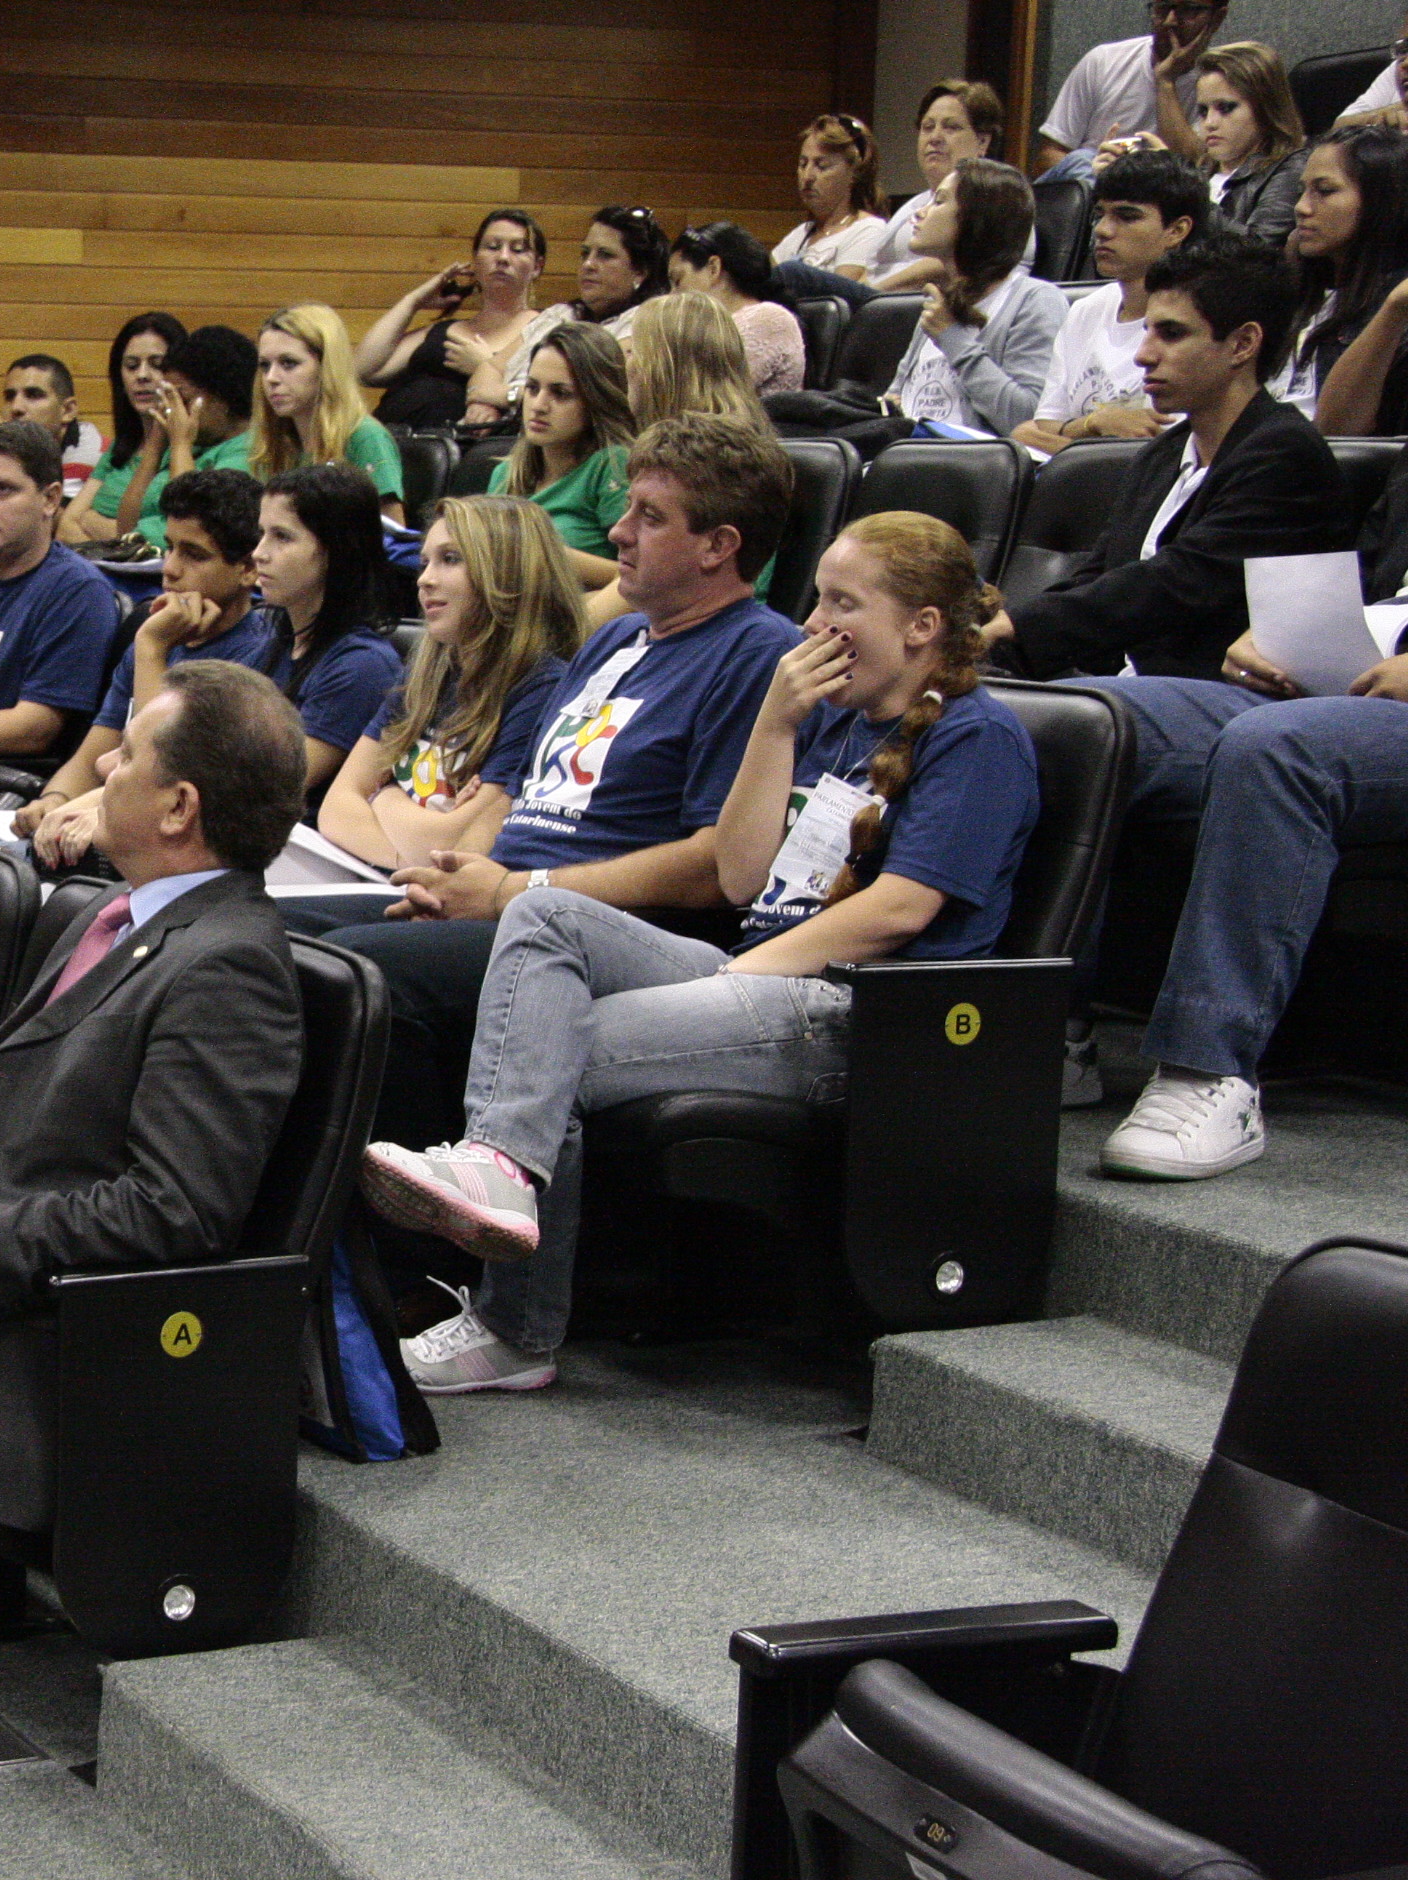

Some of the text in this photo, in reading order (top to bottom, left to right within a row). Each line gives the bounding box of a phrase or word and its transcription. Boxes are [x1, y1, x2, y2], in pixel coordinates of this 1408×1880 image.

[564, 806, 582, 821] do
[956, 1014, 971, 1035] B
[173, 1323, 192, 1346] A
